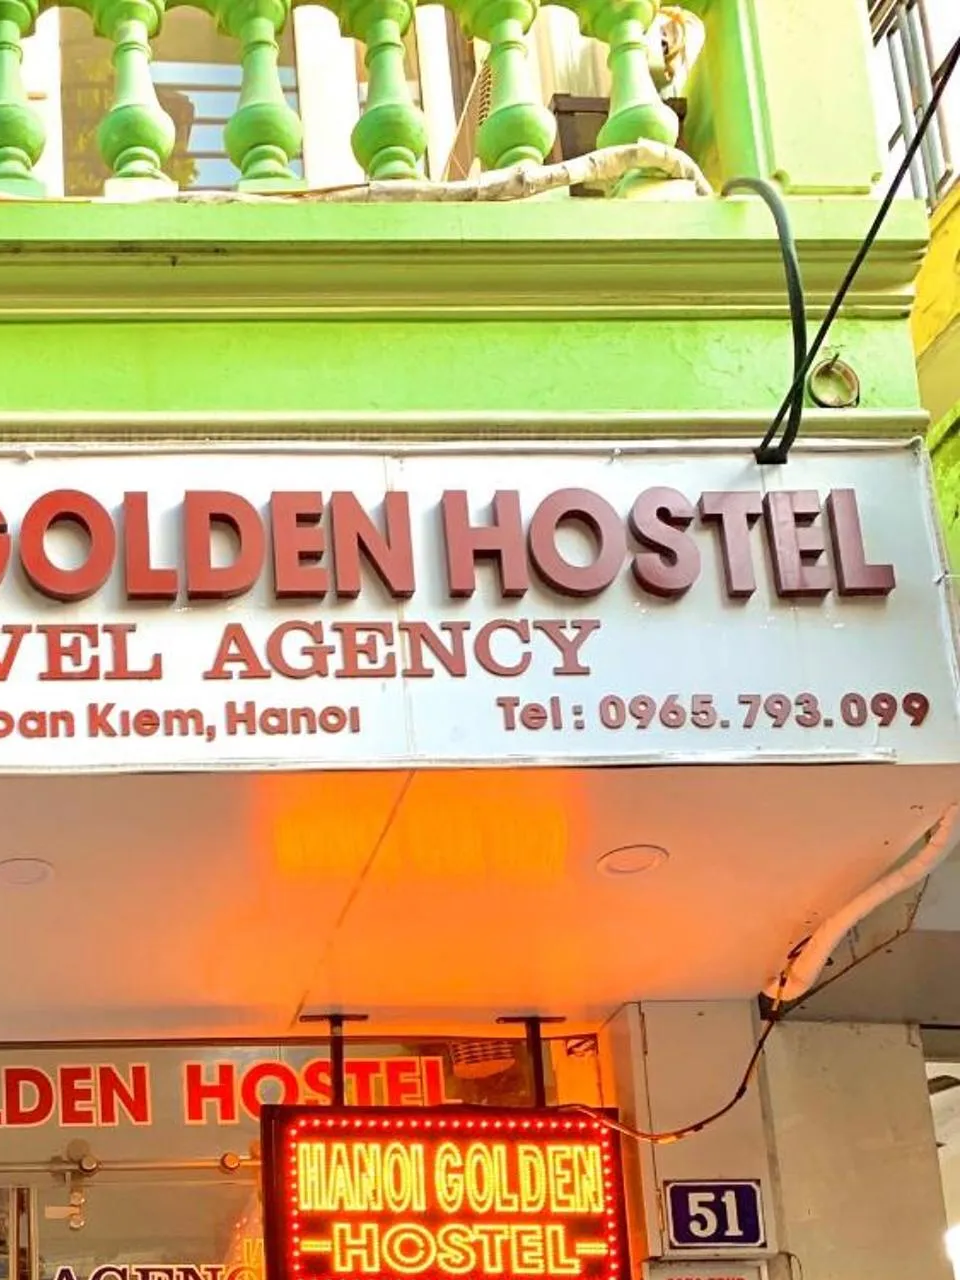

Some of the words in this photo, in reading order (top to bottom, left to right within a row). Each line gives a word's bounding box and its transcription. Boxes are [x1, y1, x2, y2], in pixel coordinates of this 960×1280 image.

[441, 486, 897, 600] HOSTEL
[204, 618, 602, 679] AGENCY
[225, 700, 361, 736] Hanoi
[599, 692, 931, 731] 0965.793.099
[296, 1142, 426, 1212] HANOI
[434, 1142, 605, 1214] GOLDEN
[687, 1190, 744, 1238] 51
